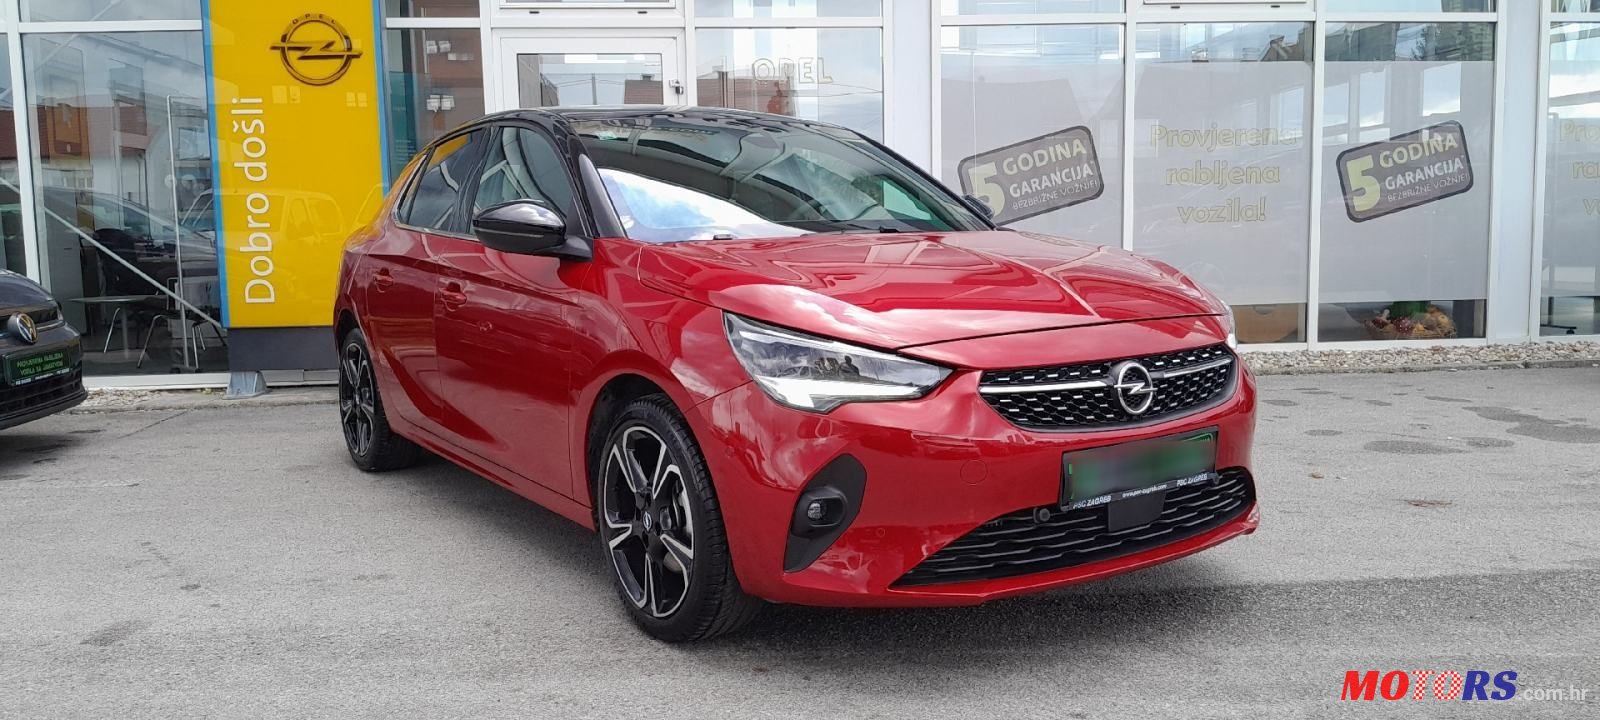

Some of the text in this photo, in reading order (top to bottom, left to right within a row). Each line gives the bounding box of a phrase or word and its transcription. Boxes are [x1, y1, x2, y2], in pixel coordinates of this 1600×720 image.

[292, 13, 336, 25] OPEL
[752, 57, 833, 84] OPEL
[1150, 122, 1297, 152] Provjerena
[1379, 133, 1459, 168] GODINA
[1003, 138, 1088, 175] GODINA
[968, 162, 1006, 217] 5
[1166, 160, 1281, 190] rabljena
[1346, 155, 1381, 212] 5
[231, 98, 275, 304] Dobro došli
[1177, 196, 1266, 224] vozila!
[1087, 495, 1112, 507] ZAGREB
